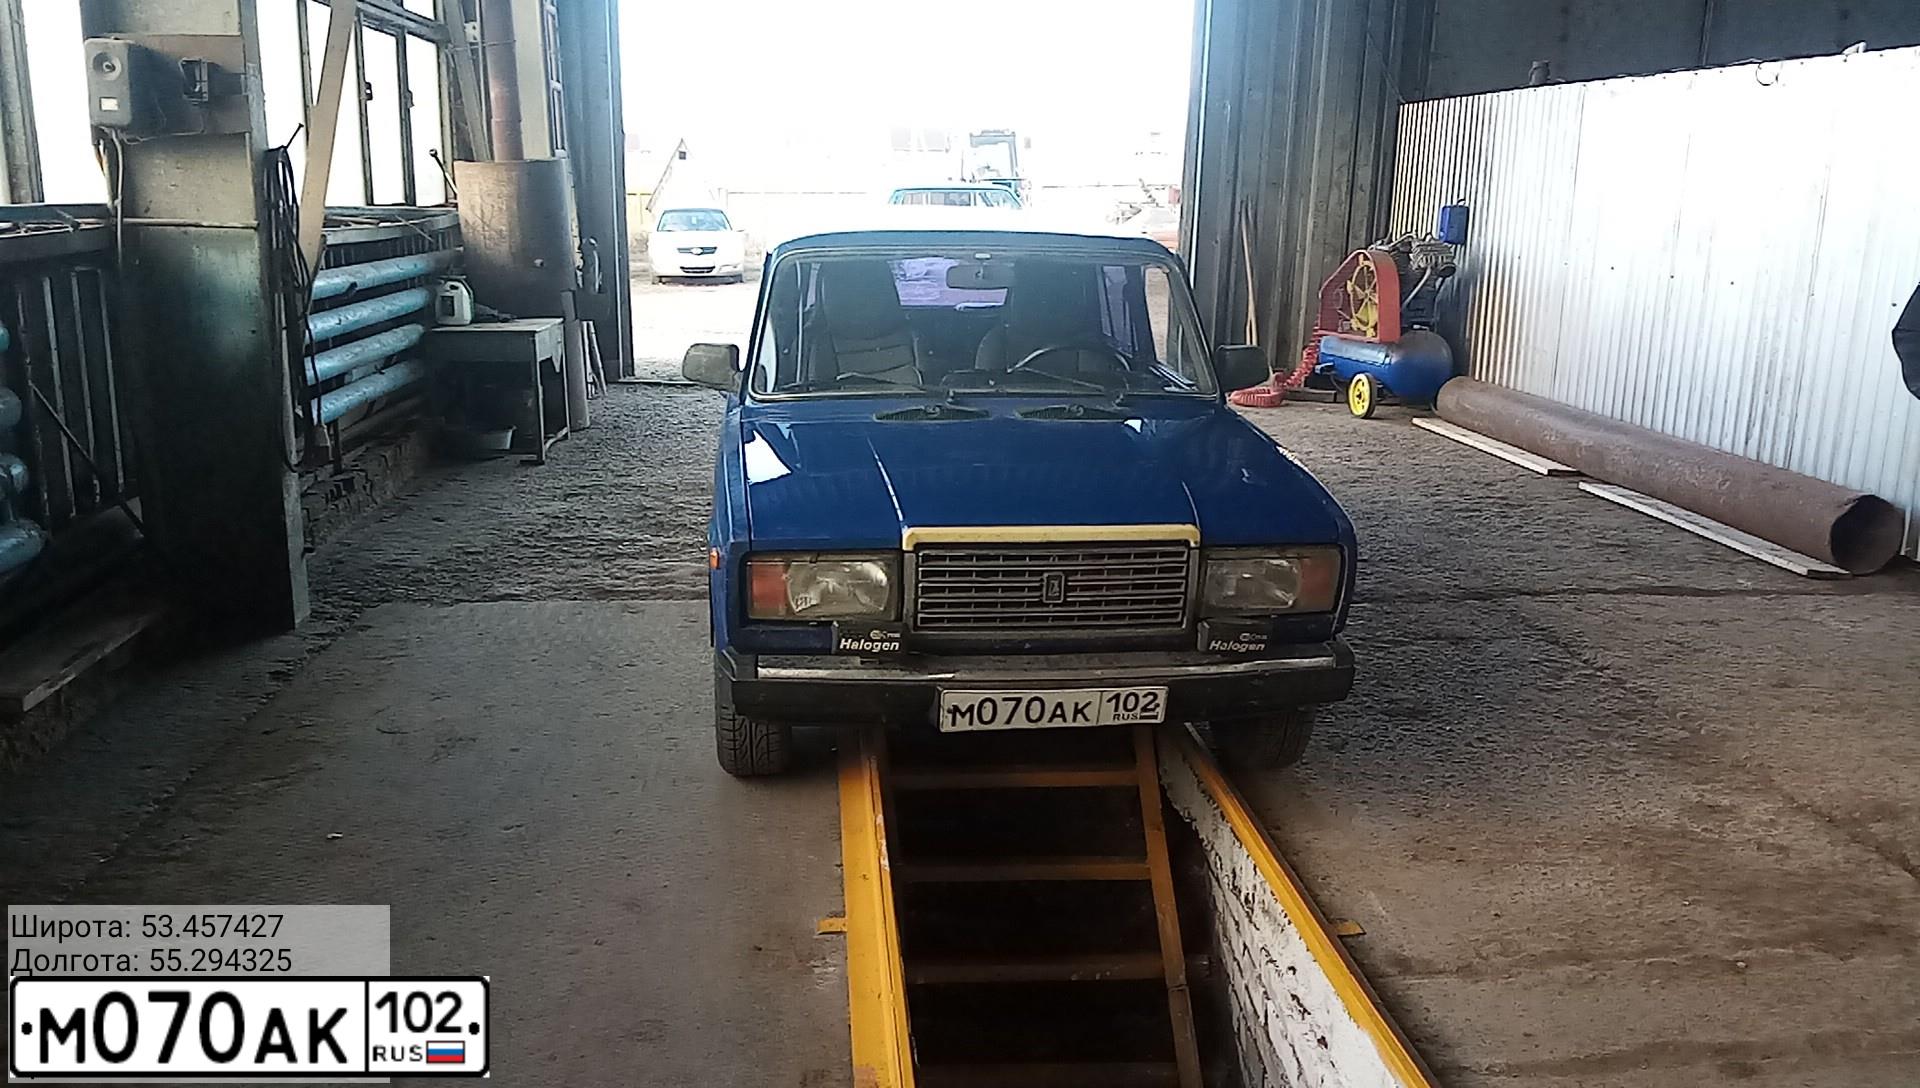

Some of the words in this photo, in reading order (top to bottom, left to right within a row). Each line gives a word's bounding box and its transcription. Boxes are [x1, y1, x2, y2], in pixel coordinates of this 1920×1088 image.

[839, 638, 900, 653] Halogen
[1209, 640, 1265, 653] Halogen
[1106, 691, 1160, 714] 102
[1112, 712, 1139, 721] RUS
